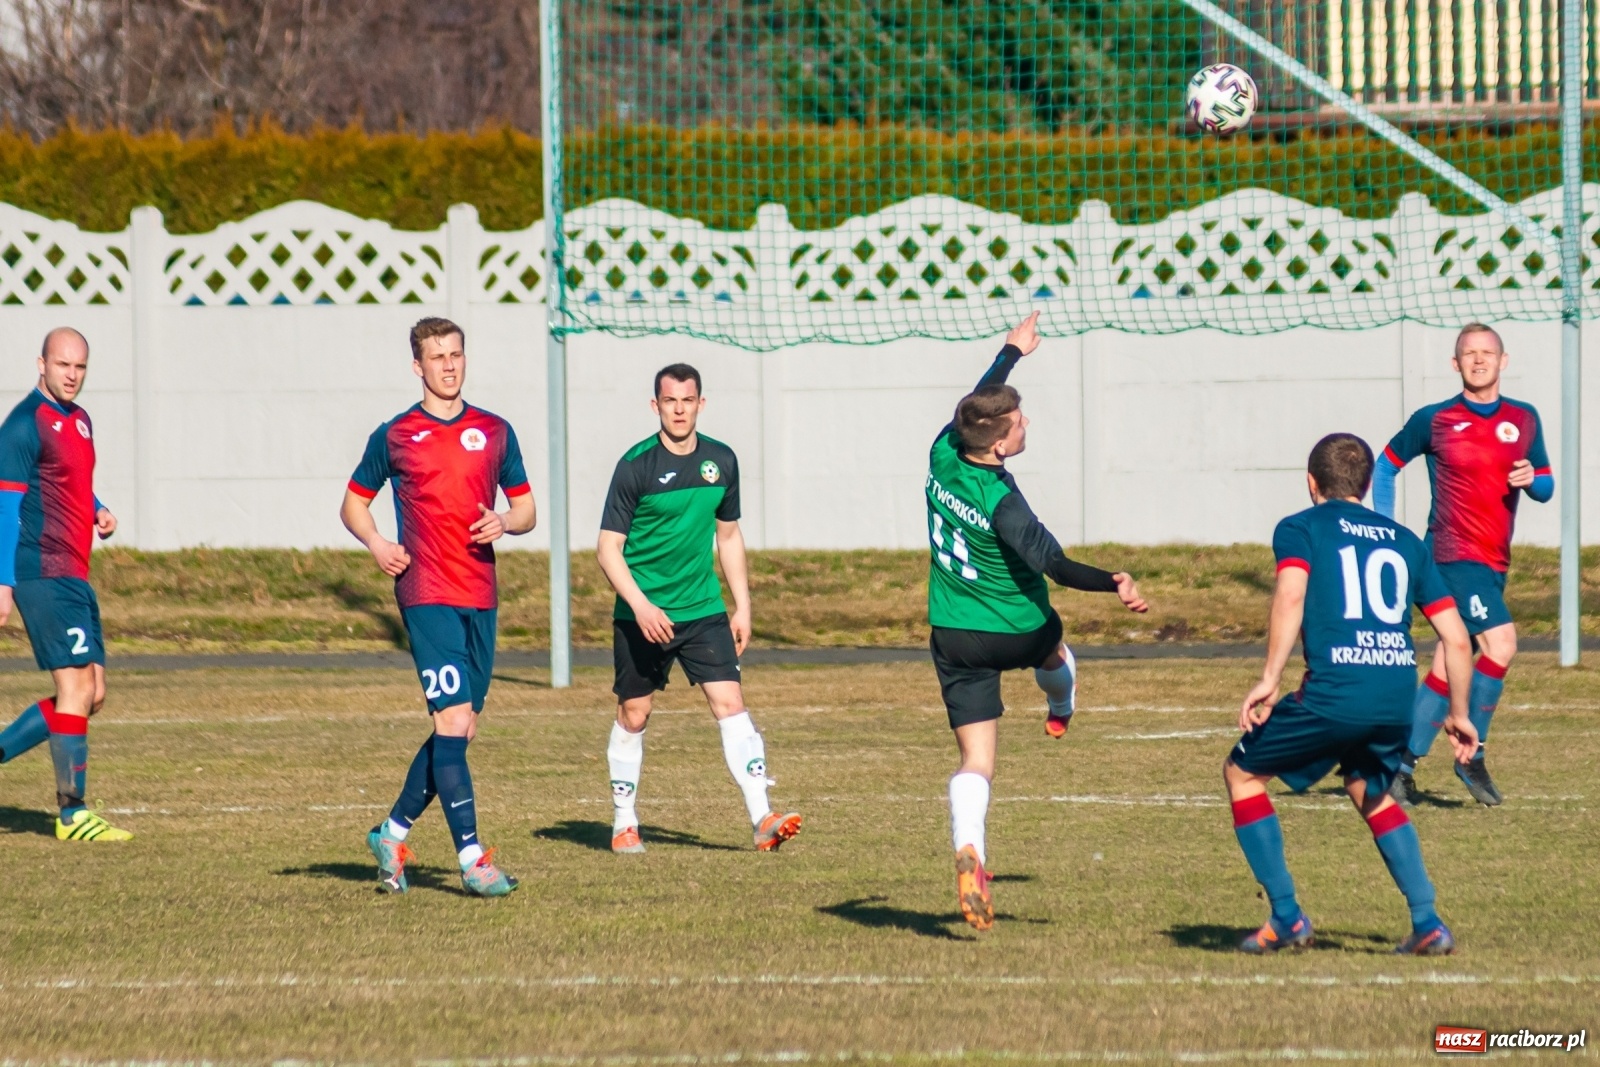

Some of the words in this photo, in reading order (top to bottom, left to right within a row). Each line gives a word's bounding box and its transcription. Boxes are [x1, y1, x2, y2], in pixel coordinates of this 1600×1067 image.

[932, 480, 991, 531] TWORKÓW
[1339, 518, 1396, 541] ŚWIĘTY
[932, 513, 978, 580] 11
[1338, 545, 1409, 624] 10
[1470, 594, 1488, 620] 4
[66, 627, 89, 655] 2
[1356, 630, 1375, 648] KS
[1376, 631, 1406, 649] 1905
[422, 664, 461, 700] 20
